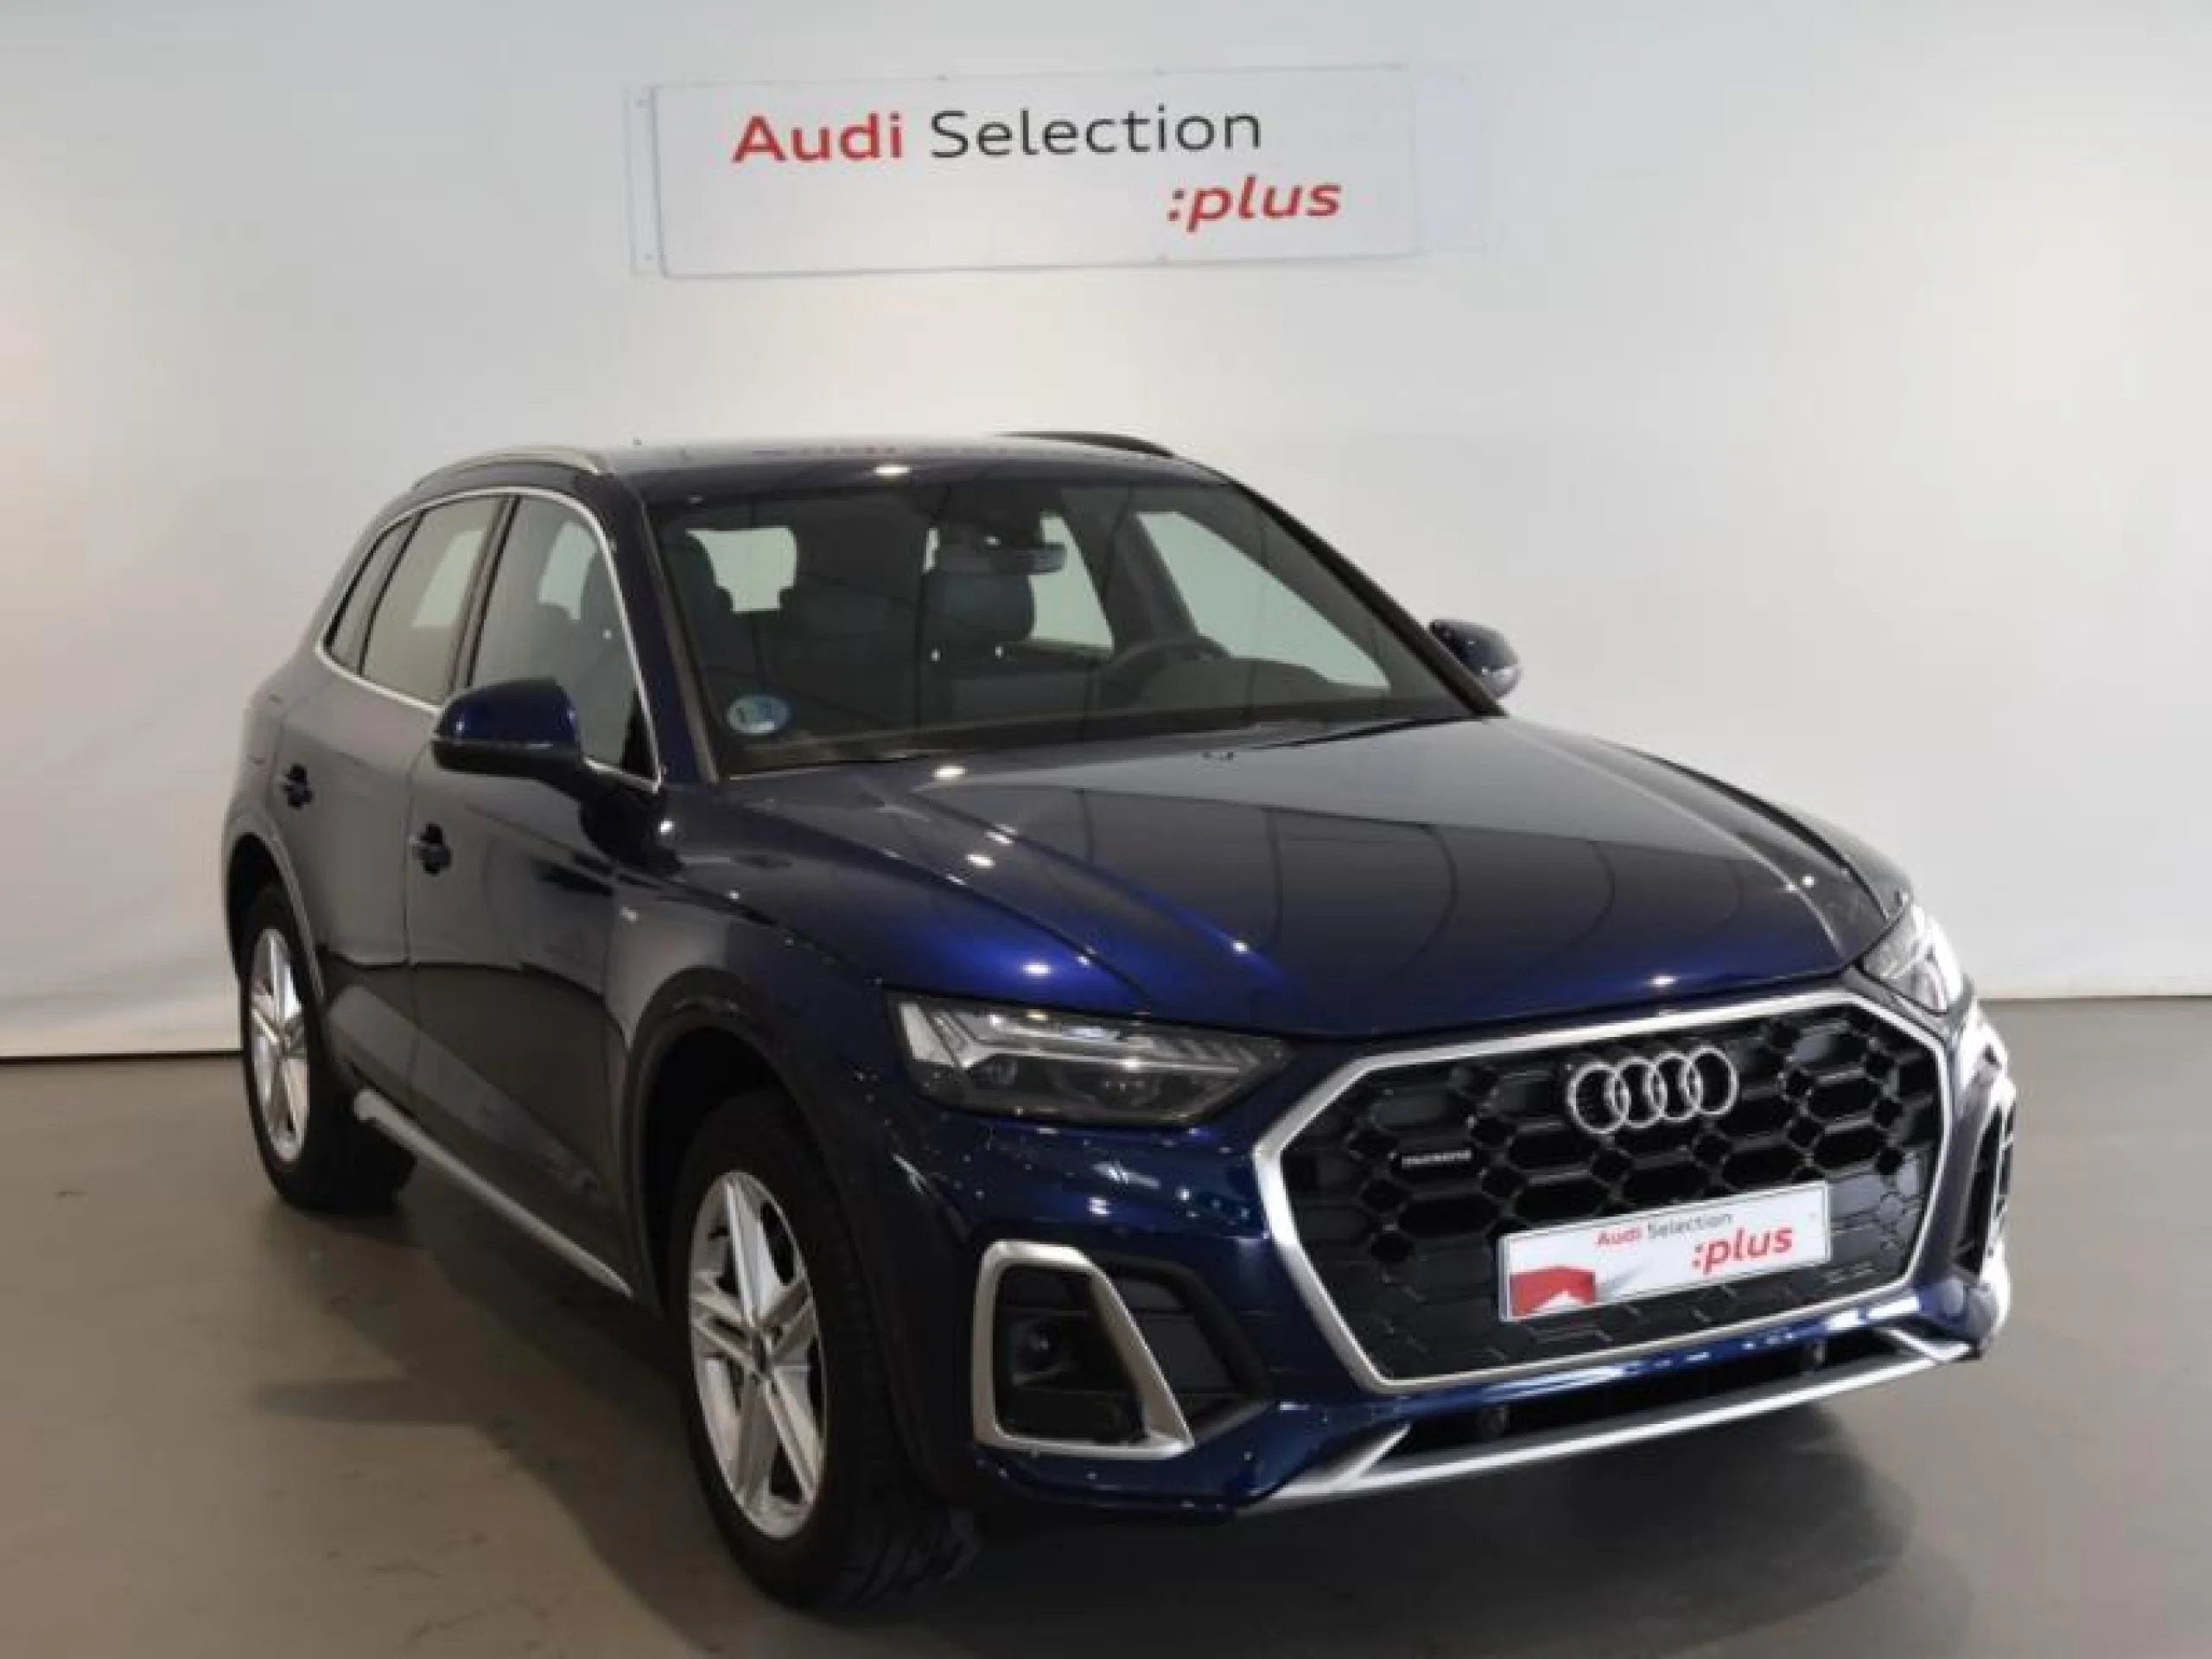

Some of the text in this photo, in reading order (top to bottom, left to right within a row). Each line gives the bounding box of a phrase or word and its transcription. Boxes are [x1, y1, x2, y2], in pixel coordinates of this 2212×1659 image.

[732, 104, 1262, 163] Audi Selection
[1167, 176, 1342, 232] :plus
[1596, 1225, 1641, 1247] Audi
[1692, 1226, 1793, 1274] :plus
